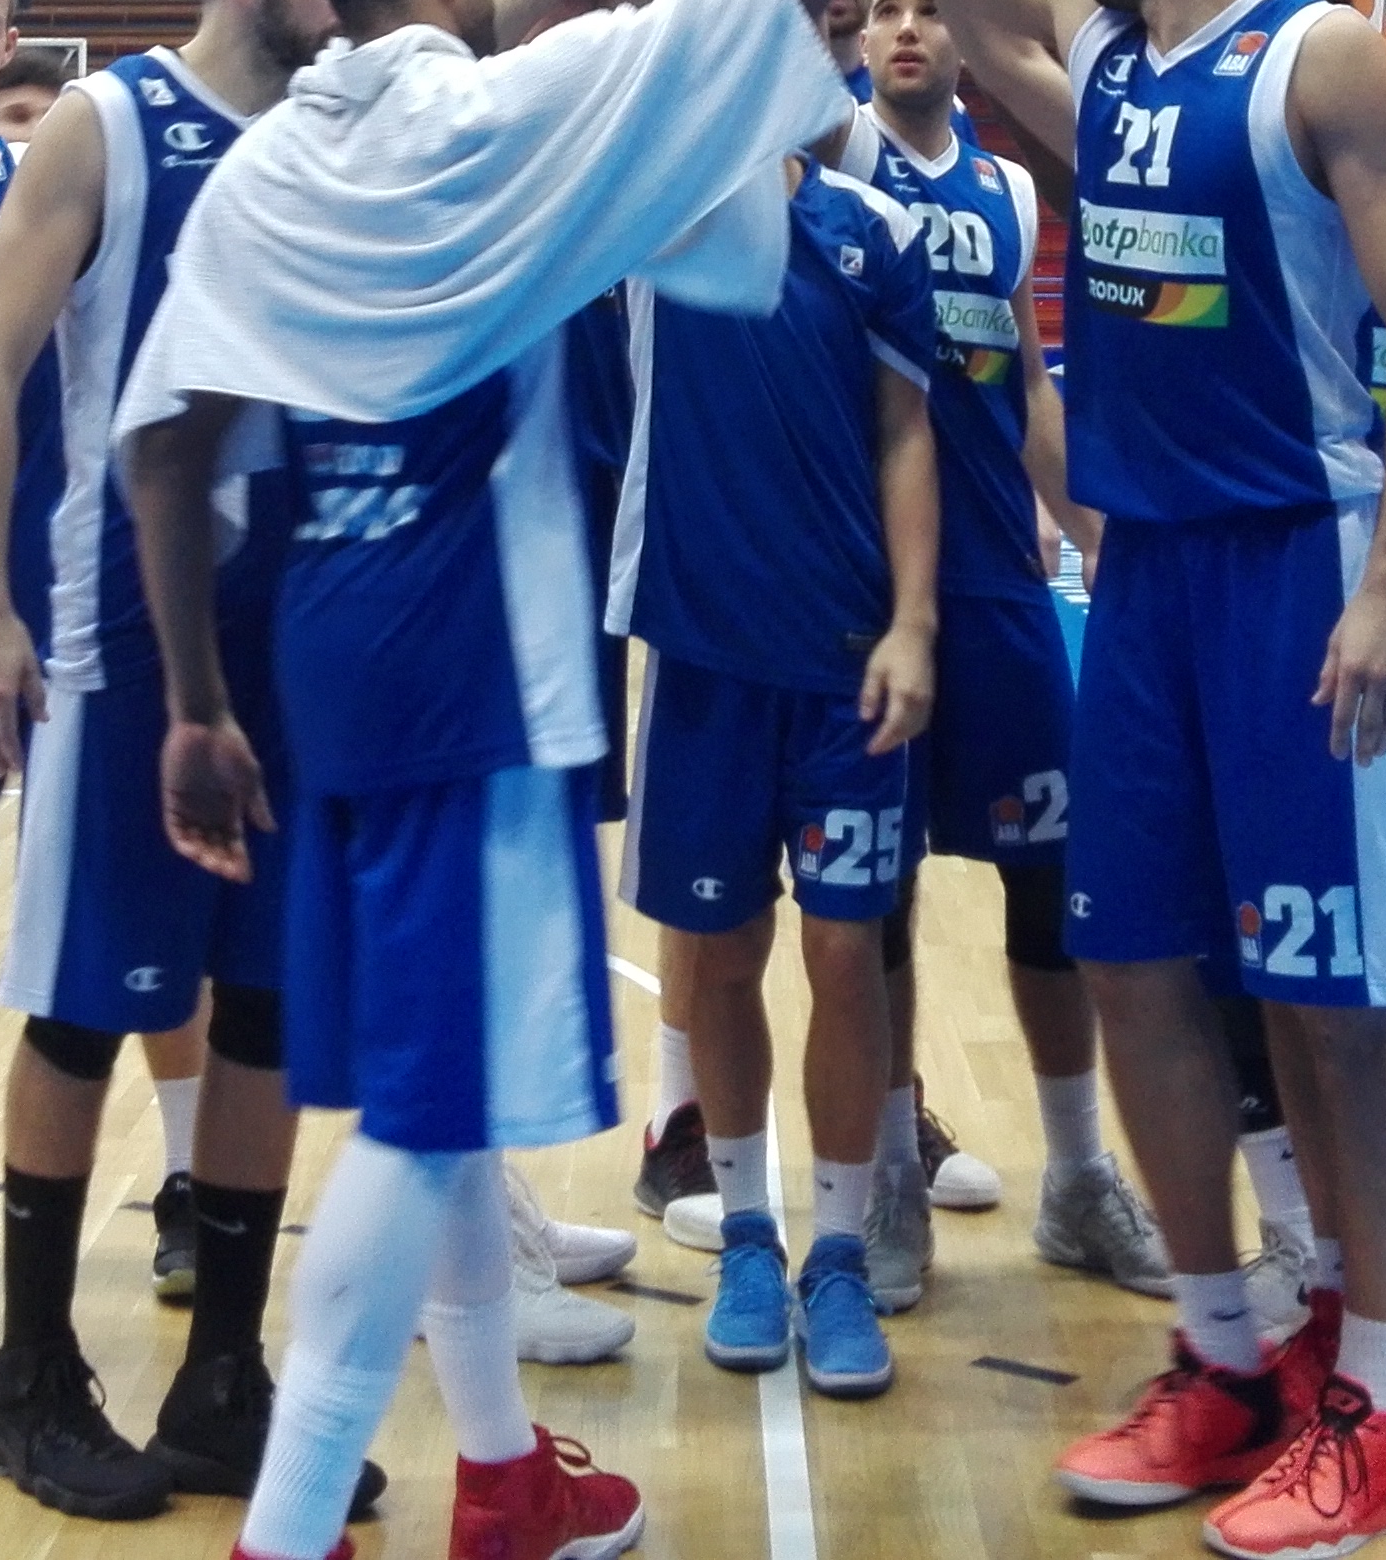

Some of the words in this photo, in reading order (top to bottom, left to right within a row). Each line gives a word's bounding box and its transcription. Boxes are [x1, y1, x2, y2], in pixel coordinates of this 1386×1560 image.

[1219, 54, 1251, 73] ABA
[908, 201, 994, 277] 20
[1092, 215, 1218, 259] otpbanka
[937, 296, 1015, 336] banka
[1023, 770, 1068, 842] 2
[820, 806, 904, 886] 25
[1263, 884, 1363, 977] 21
